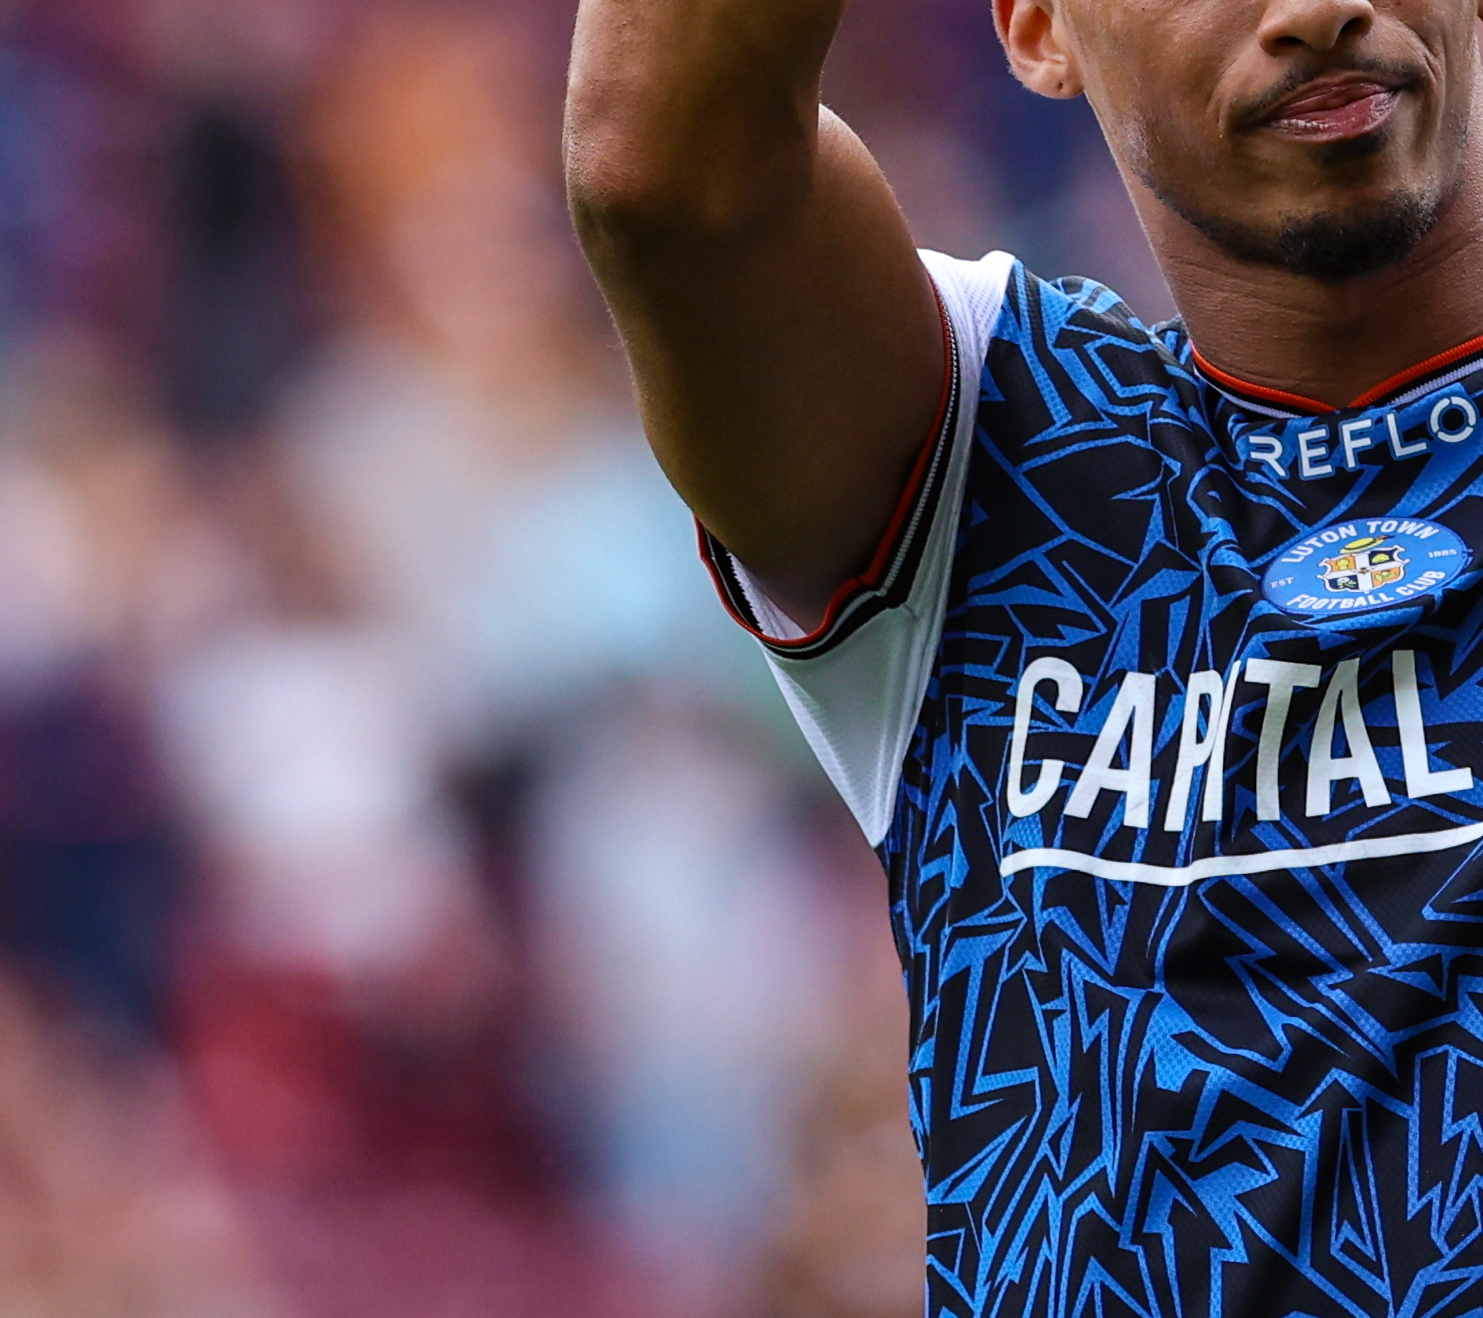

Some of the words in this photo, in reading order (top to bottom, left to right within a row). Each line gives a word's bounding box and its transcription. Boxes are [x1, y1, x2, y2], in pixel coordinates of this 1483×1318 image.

[1249, 396, 1477, 478] REFLO
[1281, 525, 1357, 564] LUTON
[1366, 521, 1440, 539] TOWN
[1271, 577, 1294, 588] EST
[1287, 593, 1394, 611] FOOTBALL
[1396, 570, 1446, 597] CLUB
[1005, 649, 1474, 833] CAPITAL
